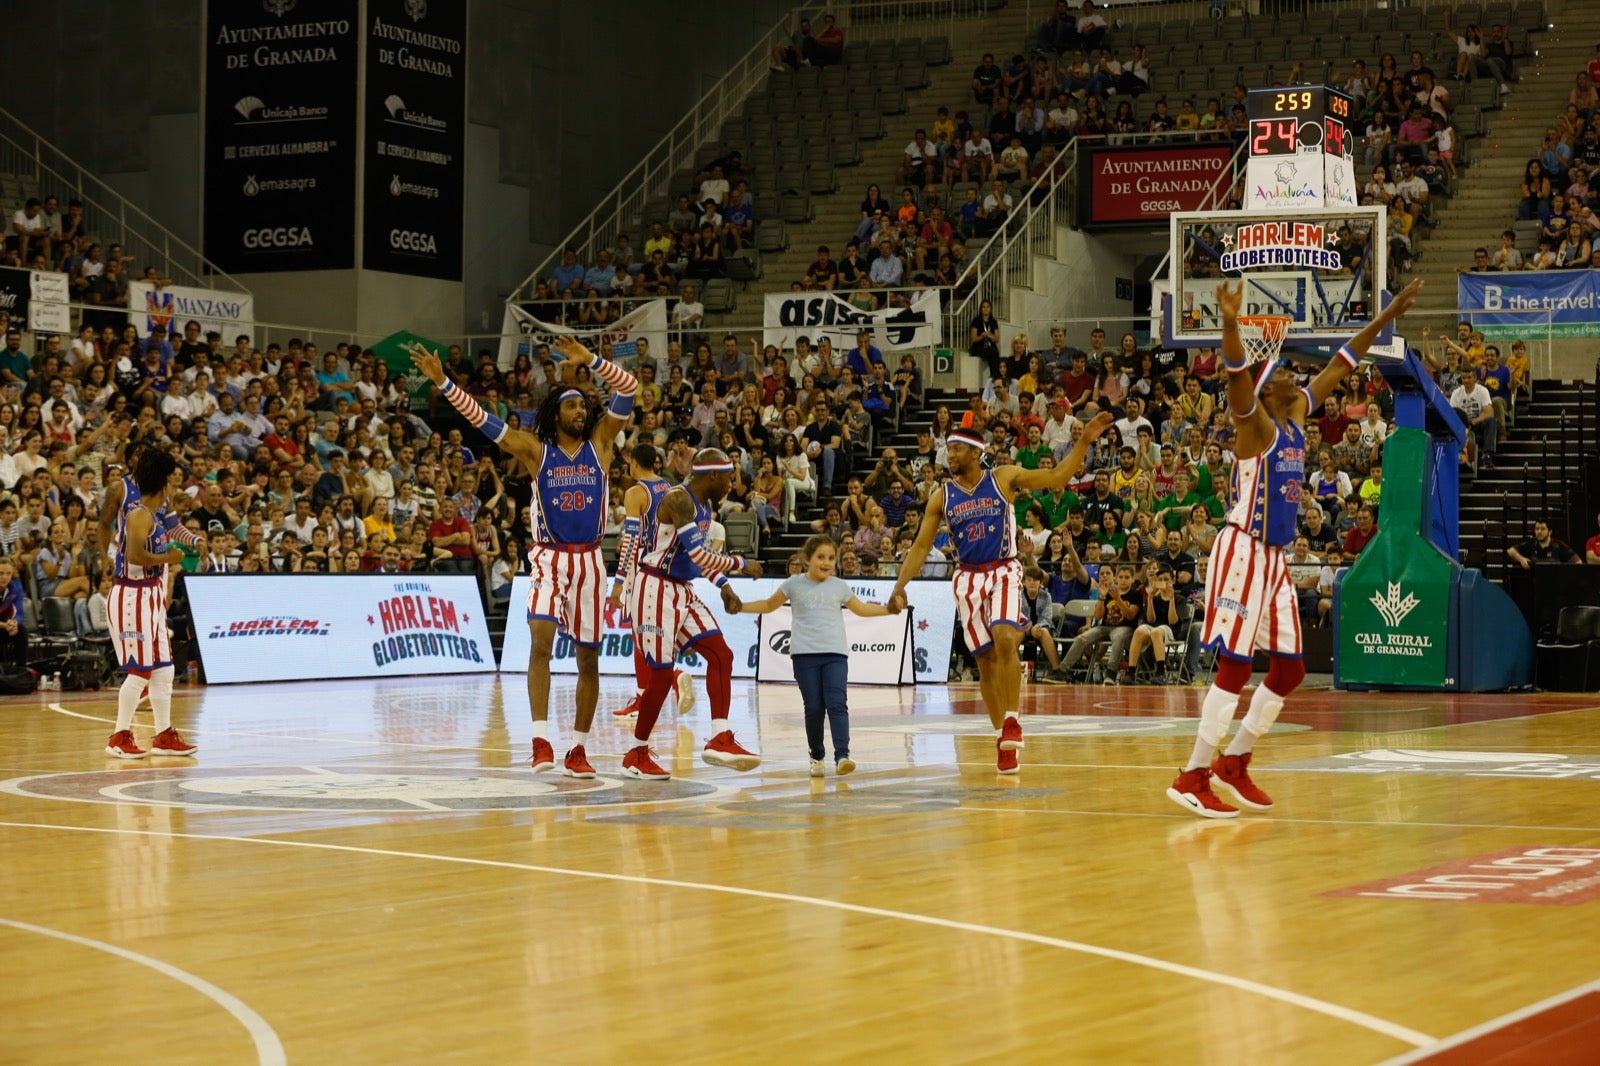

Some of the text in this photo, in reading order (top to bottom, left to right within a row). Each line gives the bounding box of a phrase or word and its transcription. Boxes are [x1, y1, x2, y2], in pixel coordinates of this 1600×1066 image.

[216, 20, 349, 44] AYUNTAMIENTO
[373, 16, 461, 54] AYUNTAMIENTO
[227, 46, 337, 69] DE GRANADA
[379, 48, 452, 77] DE GRANADA
[262, 105, 328, 119] Unicaja Banco
[1253, 121, 1296, 154] 24
[240, 144, 280, 158] CERVEZAS
[1101, 157, 1222, 175] AYUNTAMIENTO
[260, 177, 316, 191] emasagra
[401, 181, 439, 198] emasagra
[1111, 176, 1213, 195] DE GRANADA
[1238, 222, 1323, 249] HARLEM
[1221, 248, 1341, 271] GLOBETROTTERS
[1484, 285, 1594, 310] B the travel
[177, 297, 239, 319] MANZANO
[936, 356, 949, 372] D
[554, 464, 588, 478] HARLEM
[560, 491, 585, 511] 28
[953, 498, 993, 515] HARLEM
[966, 521, 985, 541] 21
[230, 620, 319, 630] HARLEM
[378, 596, 460, 635] HARLEM
[209, 628, 329, 639] GLOBETROTTERS
[1354, 633, 1432, 647] CAJA RURAL
[1363, 646, 1423, 657] DE GRANADA
